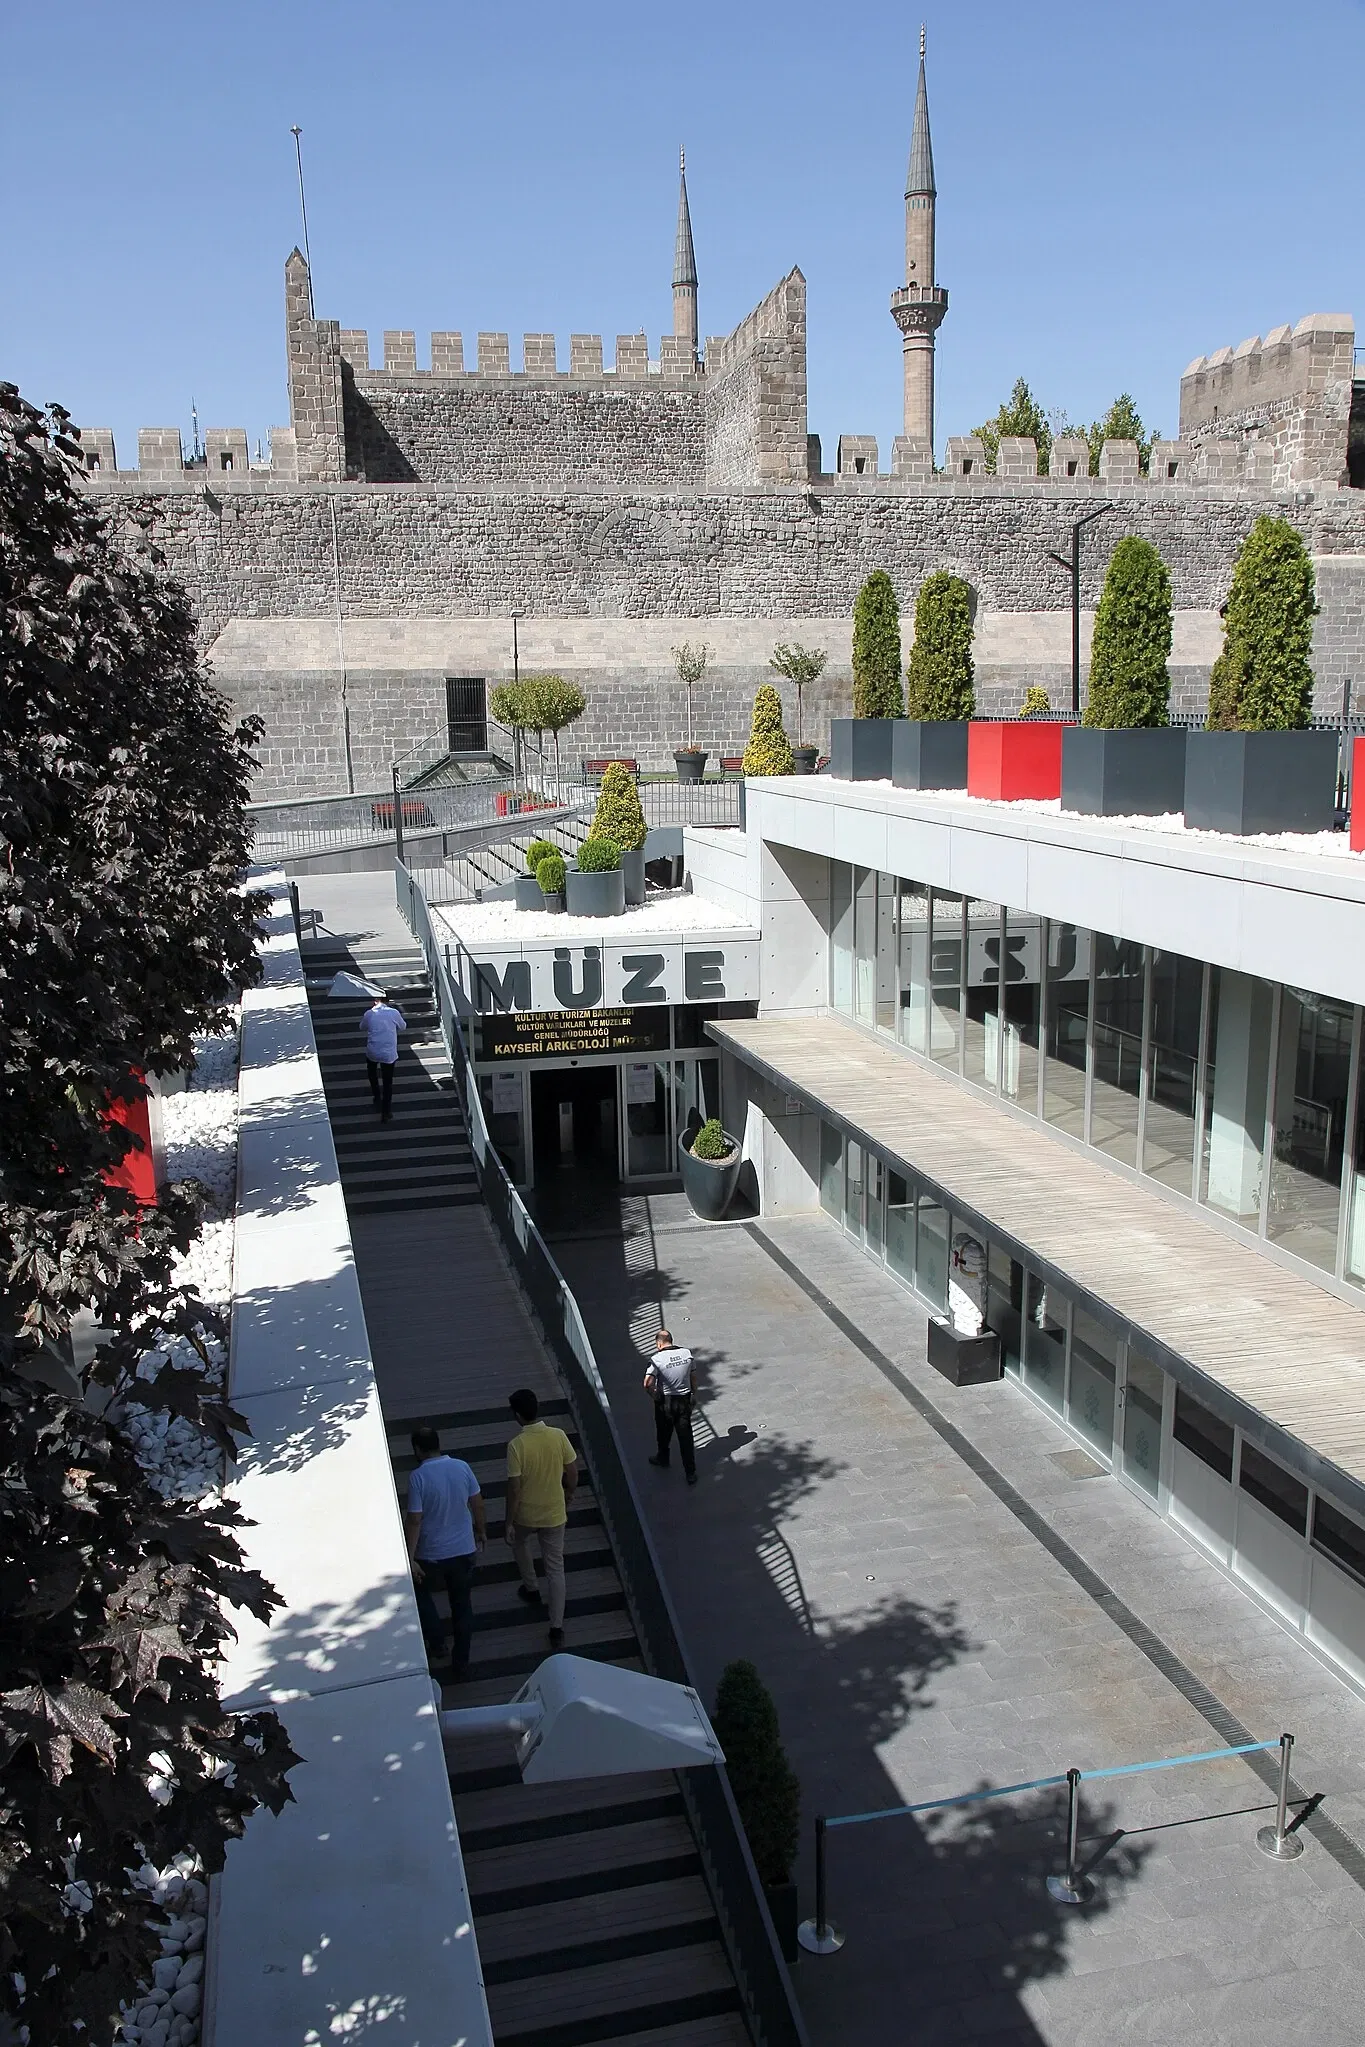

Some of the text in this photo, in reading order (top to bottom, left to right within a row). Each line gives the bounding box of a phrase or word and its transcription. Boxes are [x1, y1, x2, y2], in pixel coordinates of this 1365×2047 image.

[474, 946, 726, 1011] MÜZE
[548, 1012, 559, 1020] VE
[534, 1031, 560, 1040] GENEL
[494, 1040, 543, 1055] KAYSERİ
[546, 1036, 610, 1052] ARKEOLOJİ
